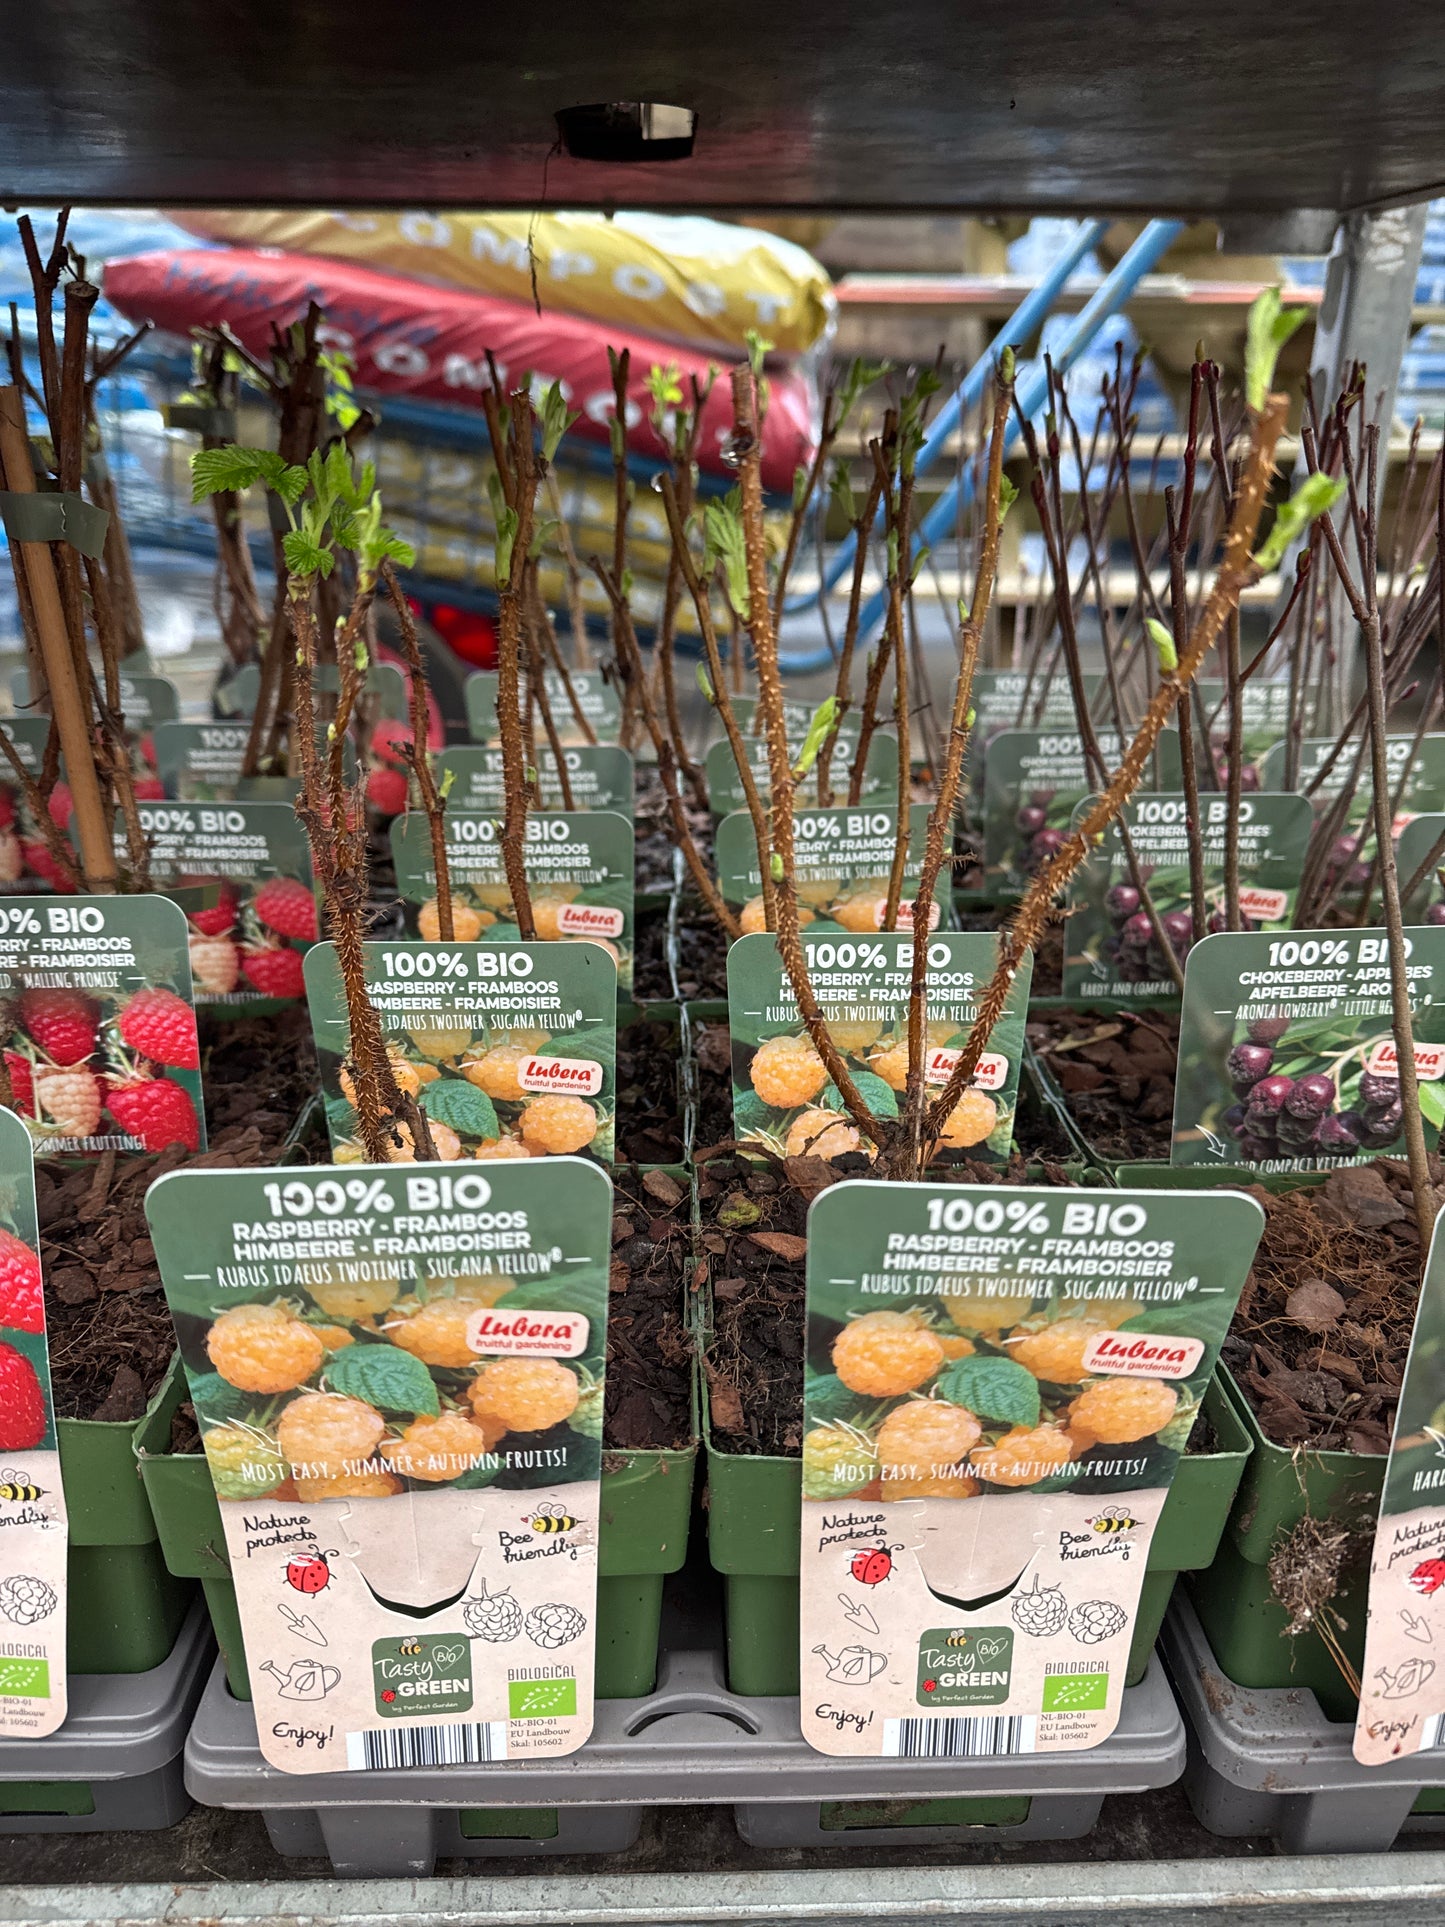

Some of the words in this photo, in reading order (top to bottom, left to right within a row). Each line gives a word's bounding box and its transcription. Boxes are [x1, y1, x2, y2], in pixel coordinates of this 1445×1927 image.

[1207, 801, 1255, 822] BO
[201, 810, 245, 832] BIO
[847, 814, 891, 836] BIO
[526, 821, 570, 841] BIO
[47, 907, 105, 934] BIO
[42, 937, 131, 951] FRAMBOOS
[1269, 940, 1349, 966] 100%
[30, 954, 136, 967] FRAMBOISIER
[382, 952, 469, 977] 100%
[477, 952, 533, 977] BIO
[805, 943, 887, 968] 100%
[897, 943, 951, 968] BO
[1239, 969, 1345, 985] CHOKEBERRY
[468, 981, 559, 994] FRAMBOOS
[1249, 984, 1347, 1000] APFELBEERE
[455, 997, 561, 1010] FRAMBOISIER
[1235, 1003, 1276, 1020] ARONIA
[387, 1014, 426, 1031] IDAEUS
[430, 1013, 484, 1030] TWOTIMER
[491, 1014, 535, 1030] SUGANA
[766, 1006, 800, 1021] RUBUS
[844, 1005, 896, 1021] TWOTIMER
[524, 1078, 549, 1088] fruitful
[551, 1081, 591, 1091] gardening
[264, 1180, 396, 1217] 100%
[406, 1175, 492, 1211] BIO
[232, 1219, 375, 1241] RASPBERRY
[393, 1211, 528, 1234] FRAMBOOS
[927, 1199, 1050, 1234] 100%
[1061, 1203, 1148, 1237] BIO
[233, 1241, 355, 1262] HIMBEERE
[373, 1232, 531, 1256] FRAMBOISIER
[888, 1234, 1026, 1255] RASPBERRY
[1041, 1239, 1174, 1258] FRAMBOOS
[216, 1264, 269, 1288] RUBUS
[274, 1261, 331, 1286] IDAEUS
[337, 1258, 417, 1283] TWOTIMER
[427, 1255, 492, 1279] SUGANA
[883, 1254, 1000, 1274] HIMBEERE
[1016, 1257, 1173, 1277] FRAMBOISIER
[860, 1275, 910, 1295] RUBUS
[916, 1275, 971, 1297] IDAEUS
[976, 1277, 1053, 1298] TWOTIMER
[1063, 1278, 1127, 1300] SUGANA
[475, 1339, 512, 1350] fruitful
[515, 1341, 572, 1352] gardening
[1089, 1357, 1125, 1372] fruitful
[1127, 1361, 1182, 1374] gardening
[242, 1462, 285, 1482] MOST
[292, 1460, 337, 1481] EASY,
[506, 1447, 567, 1470] FRUITS!
[833, 1462, 876, 1482] MOST
[881, 1462, 923, 1482] EASY,
[1087, 1457, 1147, 1477] FRUITS!
[243, 1514, 311, 1533] Nature
[822, 1512, 886, 1530] Nature
[246, 1531, 317, 1557] protects
[498, 1531, 534, 1547] Bee
[818, 1528, 887, 1552] protects
[1059, 1531, 1092, 1545] Bee
[502, 1541, 579, 1563] friendly
[436, 1651, 456, 1663] BIO
[980, 1644, 998, 1656] BIO
[375, 1658, 433, 1683] Tasty
[921, 1649, 976, 1674] Tasty
[1044, 1661, 1110, 1675] BIOLOGICAL
[507, 1665, 576, 1680] BIOLOGICAL
[939, 1671, 1007, 1687] GREEN
[398, 1678, 469, 1696] GREEN
[510, 1718, 557, 1727] NL-BIO-01
[815, 1703, 874, 1733] Enjoy!
[1041, 1713, 1086, 1721] NL-BIO-01
[524, 1727, 570, 1736] Landbouw
[1040, 1723, 1053, 1731] EU
[1055, 1722, 1097, 1731] Landbouw
[1371, 1714, 1418, 1743] Enjoy!
[272, 1722, 334, 1750] Enjoy!
[510, 1740, 531, 1748] Skal:
[533, 1739, 563, 1747] 105602
[1039, 1733, 1058, 1742] Skal:
[1060, 1732, 1088, 1740] 105602
